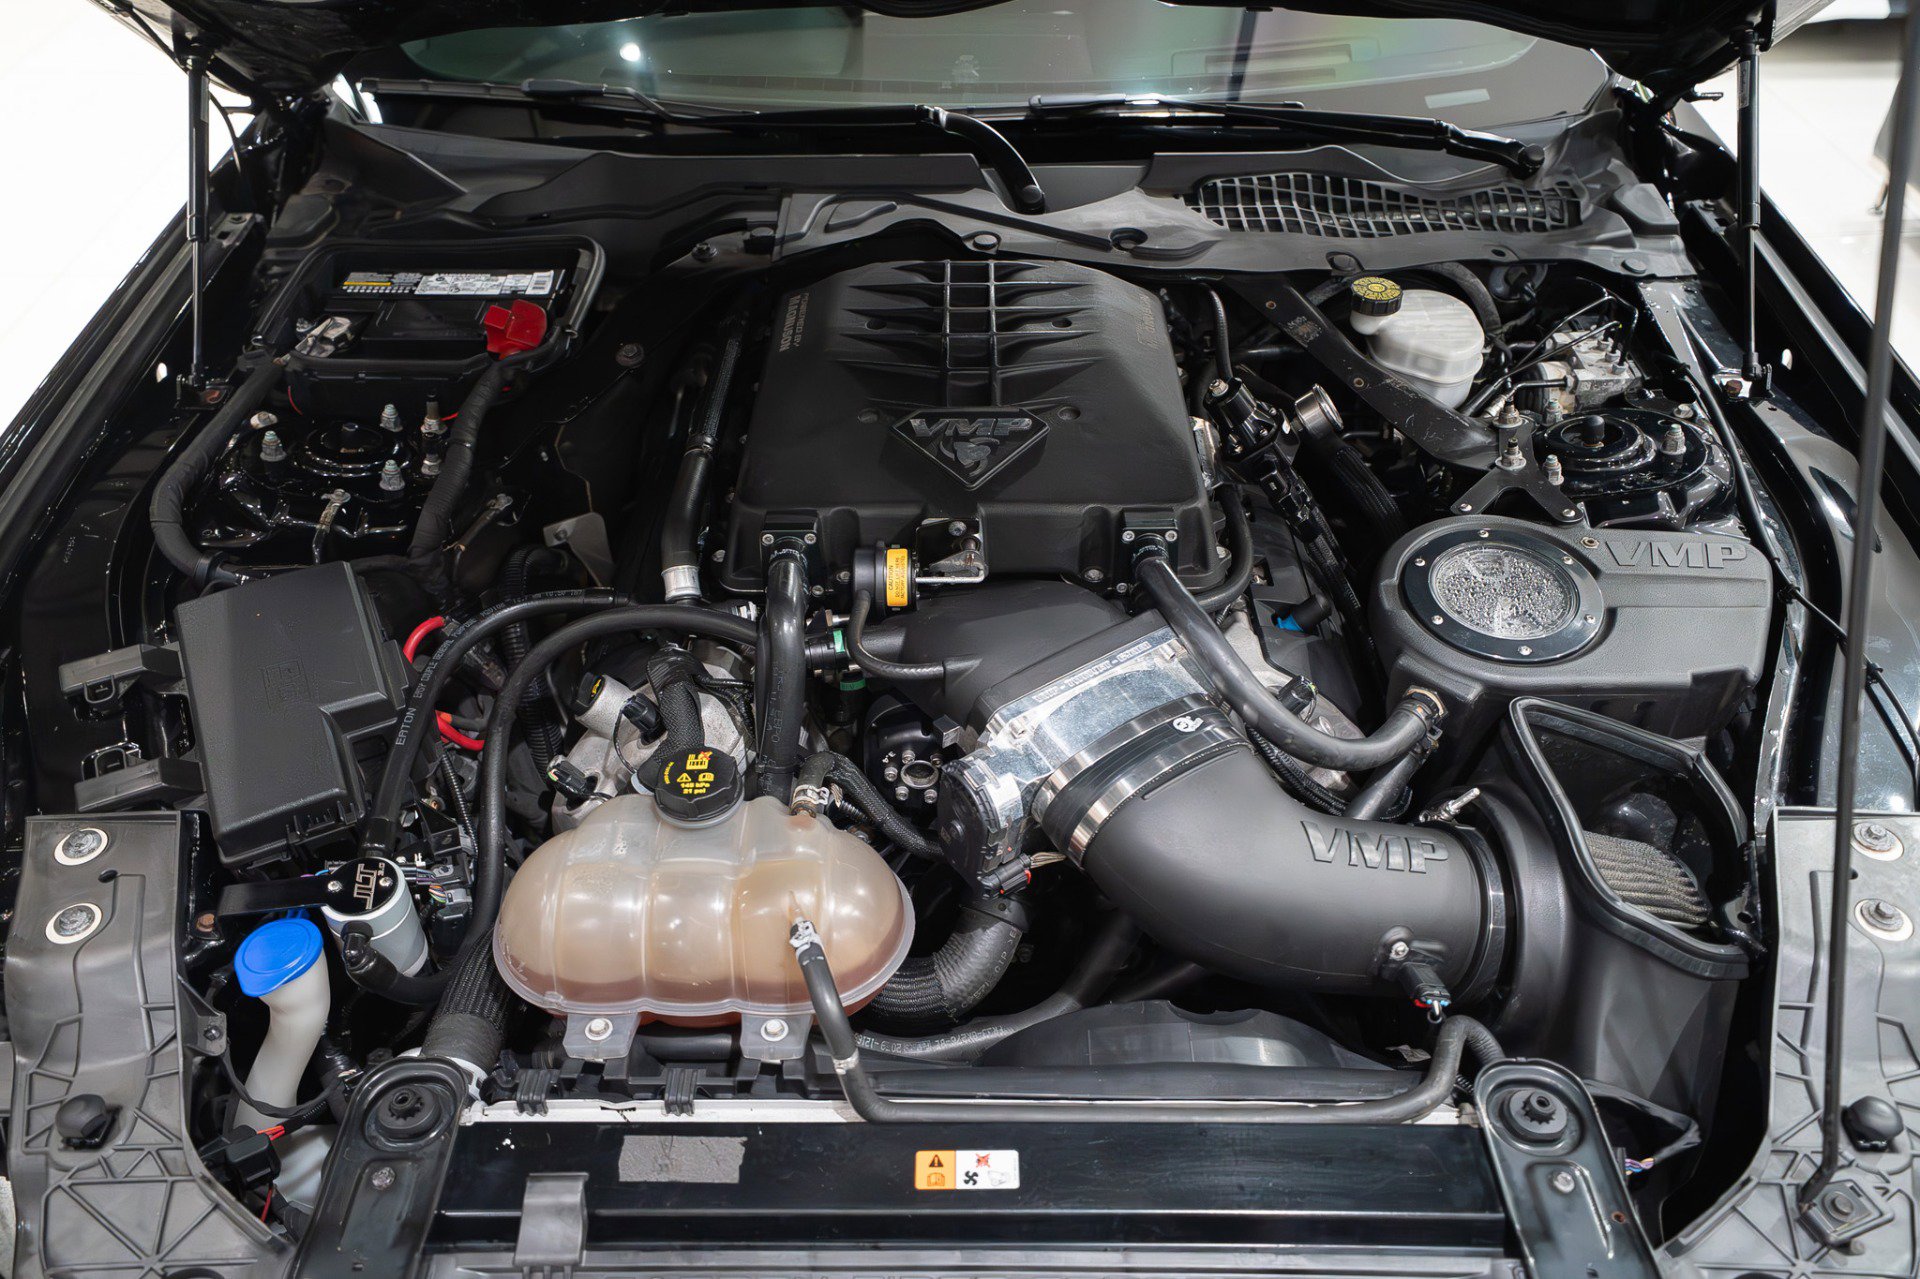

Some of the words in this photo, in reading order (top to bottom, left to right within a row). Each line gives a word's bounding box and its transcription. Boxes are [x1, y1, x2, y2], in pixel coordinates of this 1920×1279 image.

[778, 293, 801, 352] MAGNUSON
[909, 418, 1033, 437] VMP
[1604, 540, 1748, 569] VMP
[395, 707, 417, 746] EATON
[1300, 820, 1448, 874] VMP
[353, 863, 377, 910] JLT
